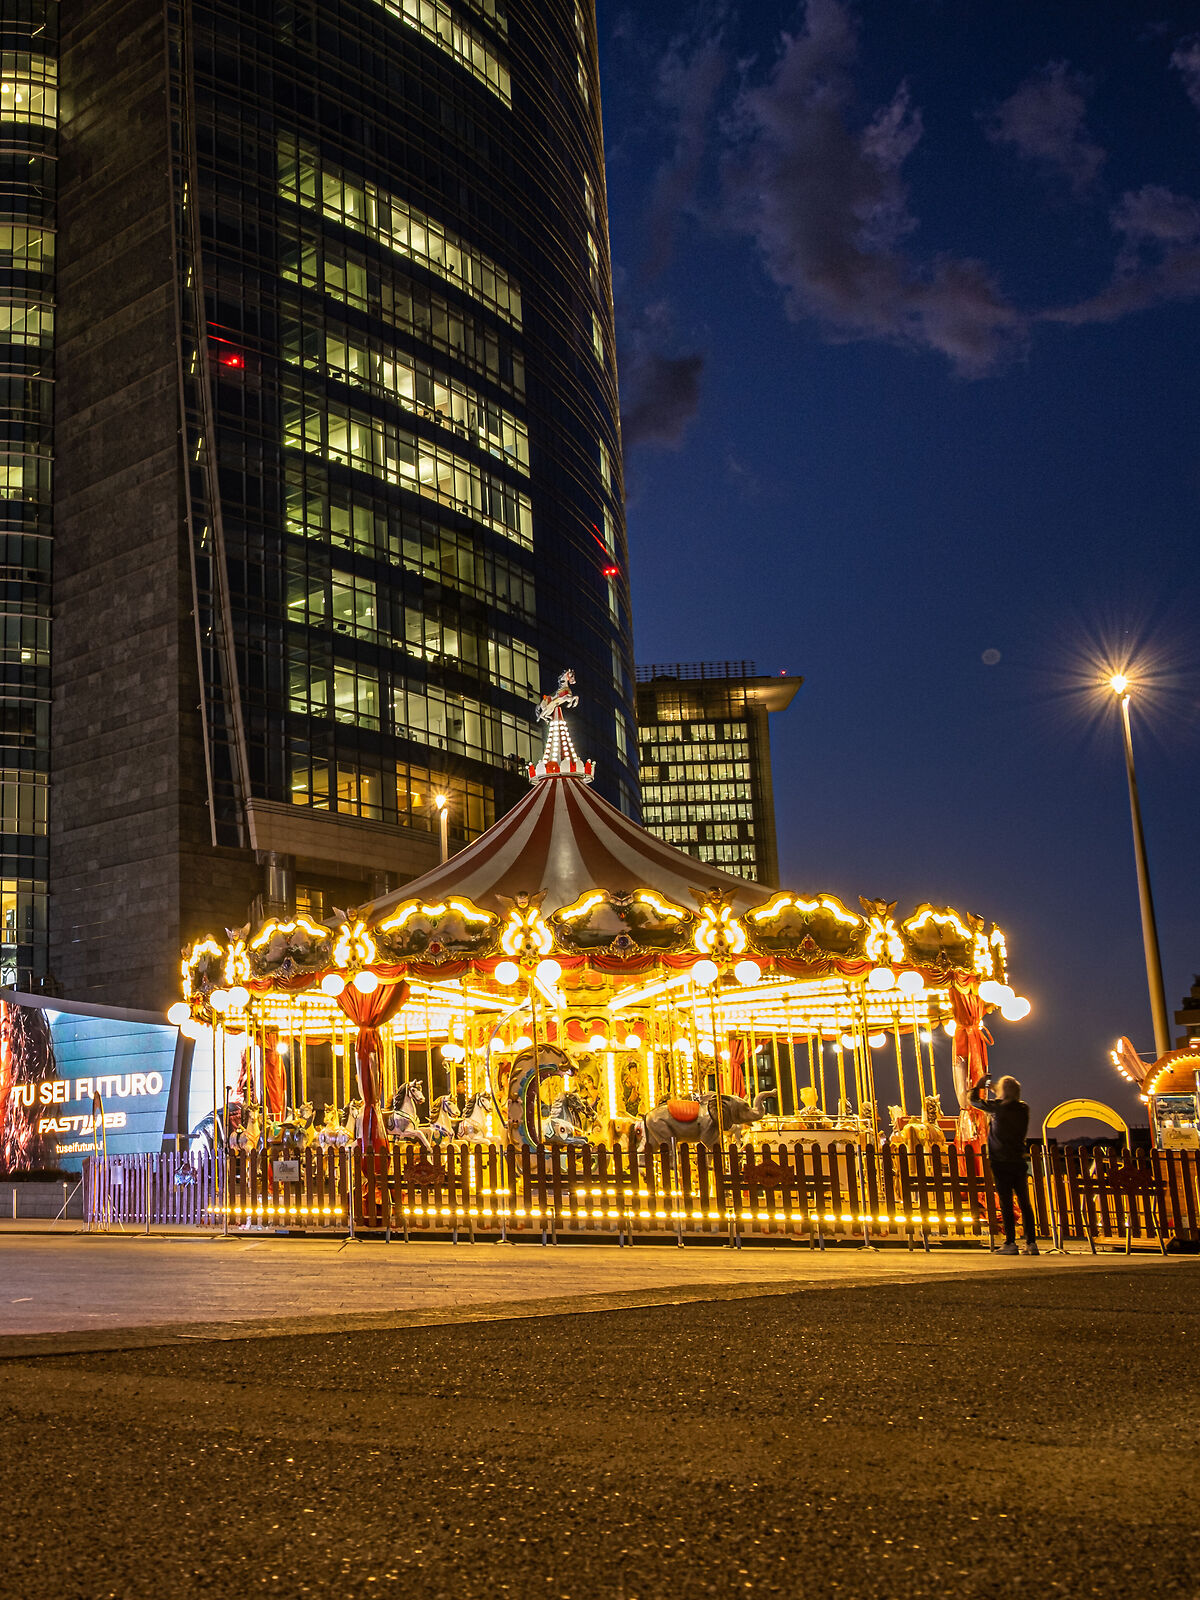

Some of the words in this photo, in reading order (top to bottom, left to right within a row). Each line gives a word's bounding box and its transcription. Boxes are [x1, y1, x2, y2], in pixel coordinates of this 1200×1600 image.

[11, 1084, 35, 1107] TU
[39, 1080, 70, 1104] SEI
[75, 1071, 163, 1101] FUTURO
[38, 1112, 127, 1136] FASTWEB
[55, 1140, 104, 1154] tuseifuturo.i
